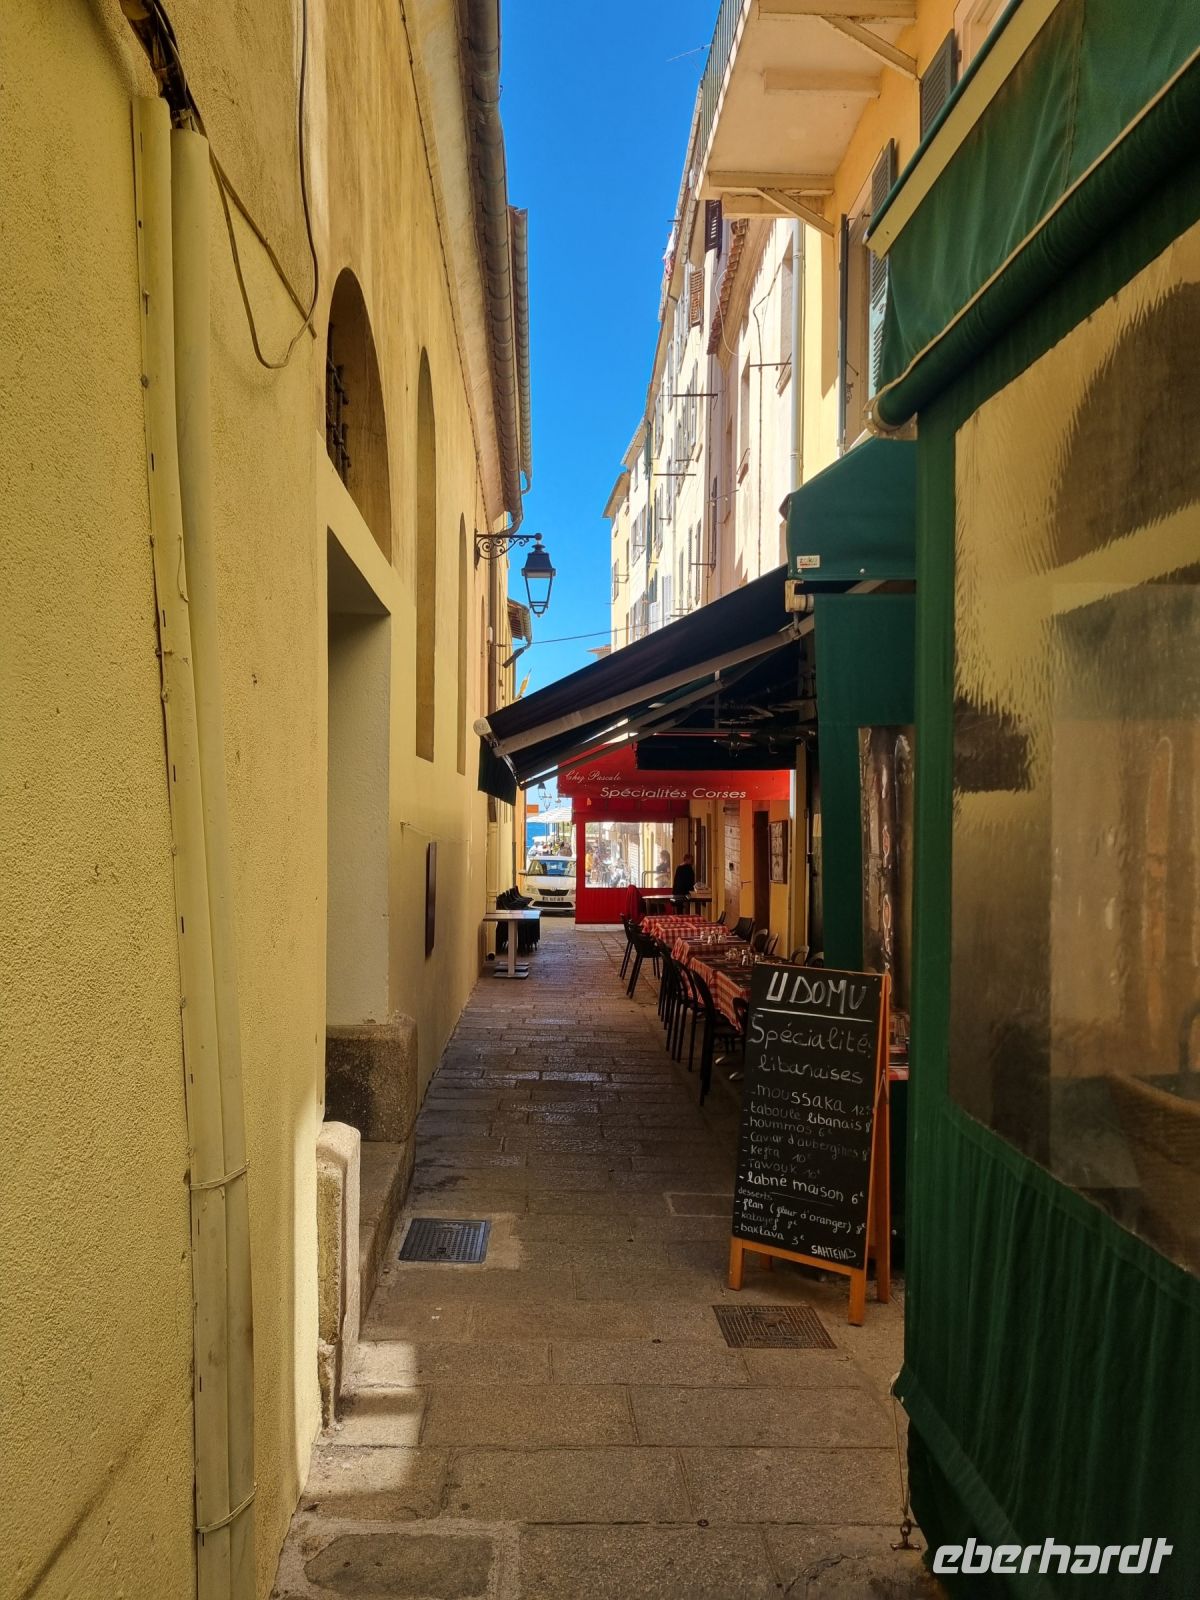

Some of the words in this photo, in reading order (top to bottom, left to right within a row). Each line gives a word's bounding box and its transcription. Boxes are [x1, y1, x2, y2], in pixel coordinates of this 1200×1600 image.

[600, 786, 687, 799] Spécialités
[692, 786, 747, 799] Corses
[757, 1054, 864, 1085] libanaises
[807, 1112, 863, 1131] libanais
[747, 1170, 788, 1187] labné
[792, 1179, 844, 1202] maison
